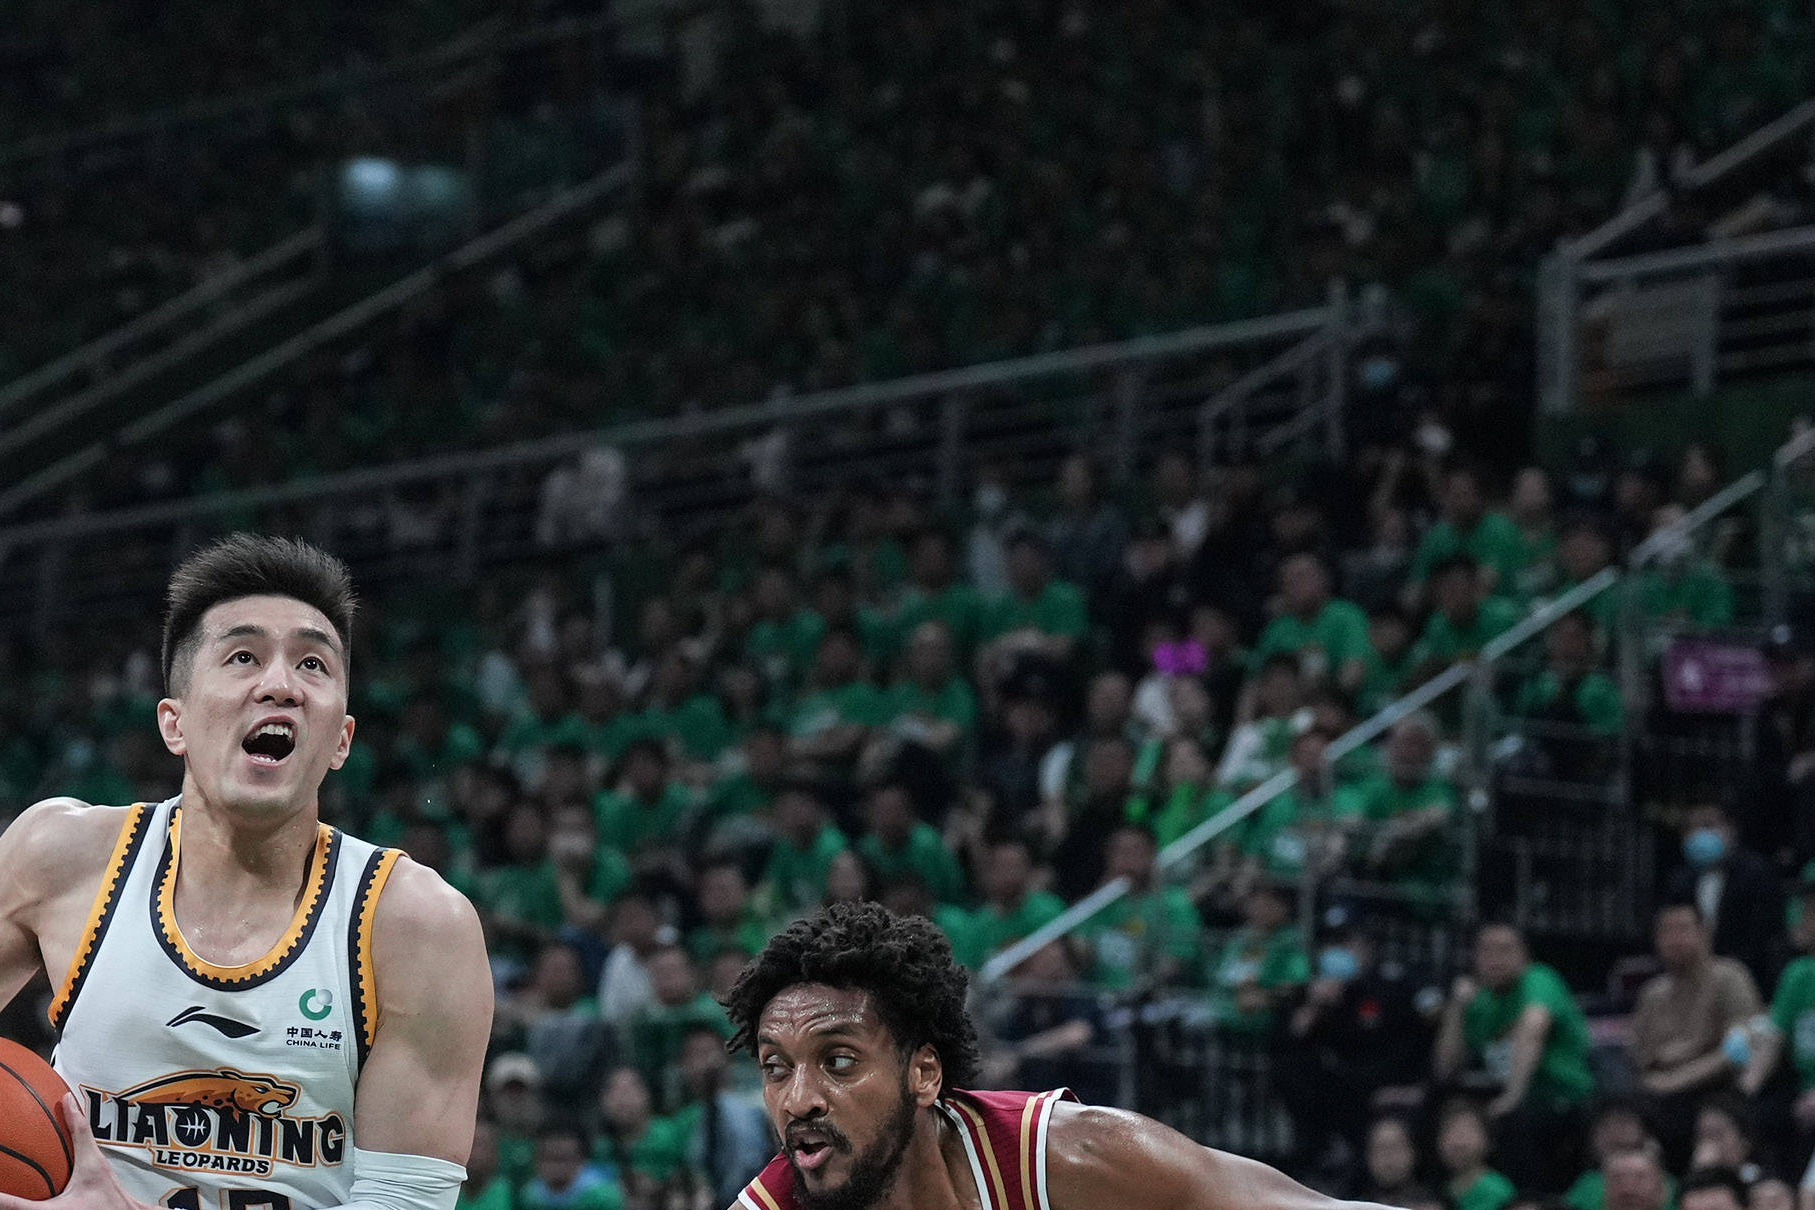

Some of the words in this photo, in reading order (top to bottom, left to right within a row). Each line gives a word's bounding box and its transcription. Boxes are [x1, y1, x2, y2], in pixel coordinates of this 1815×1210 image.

[286, 1026, 343, 1042] 中国人寿
[286, 1039, 317, 1048] CHINA
[319, 1042, 342, 1051] LIFE
[84, 1088, 346, 1166] LIAONING
[156, 1150, 271, 1175] LEOPARDS
